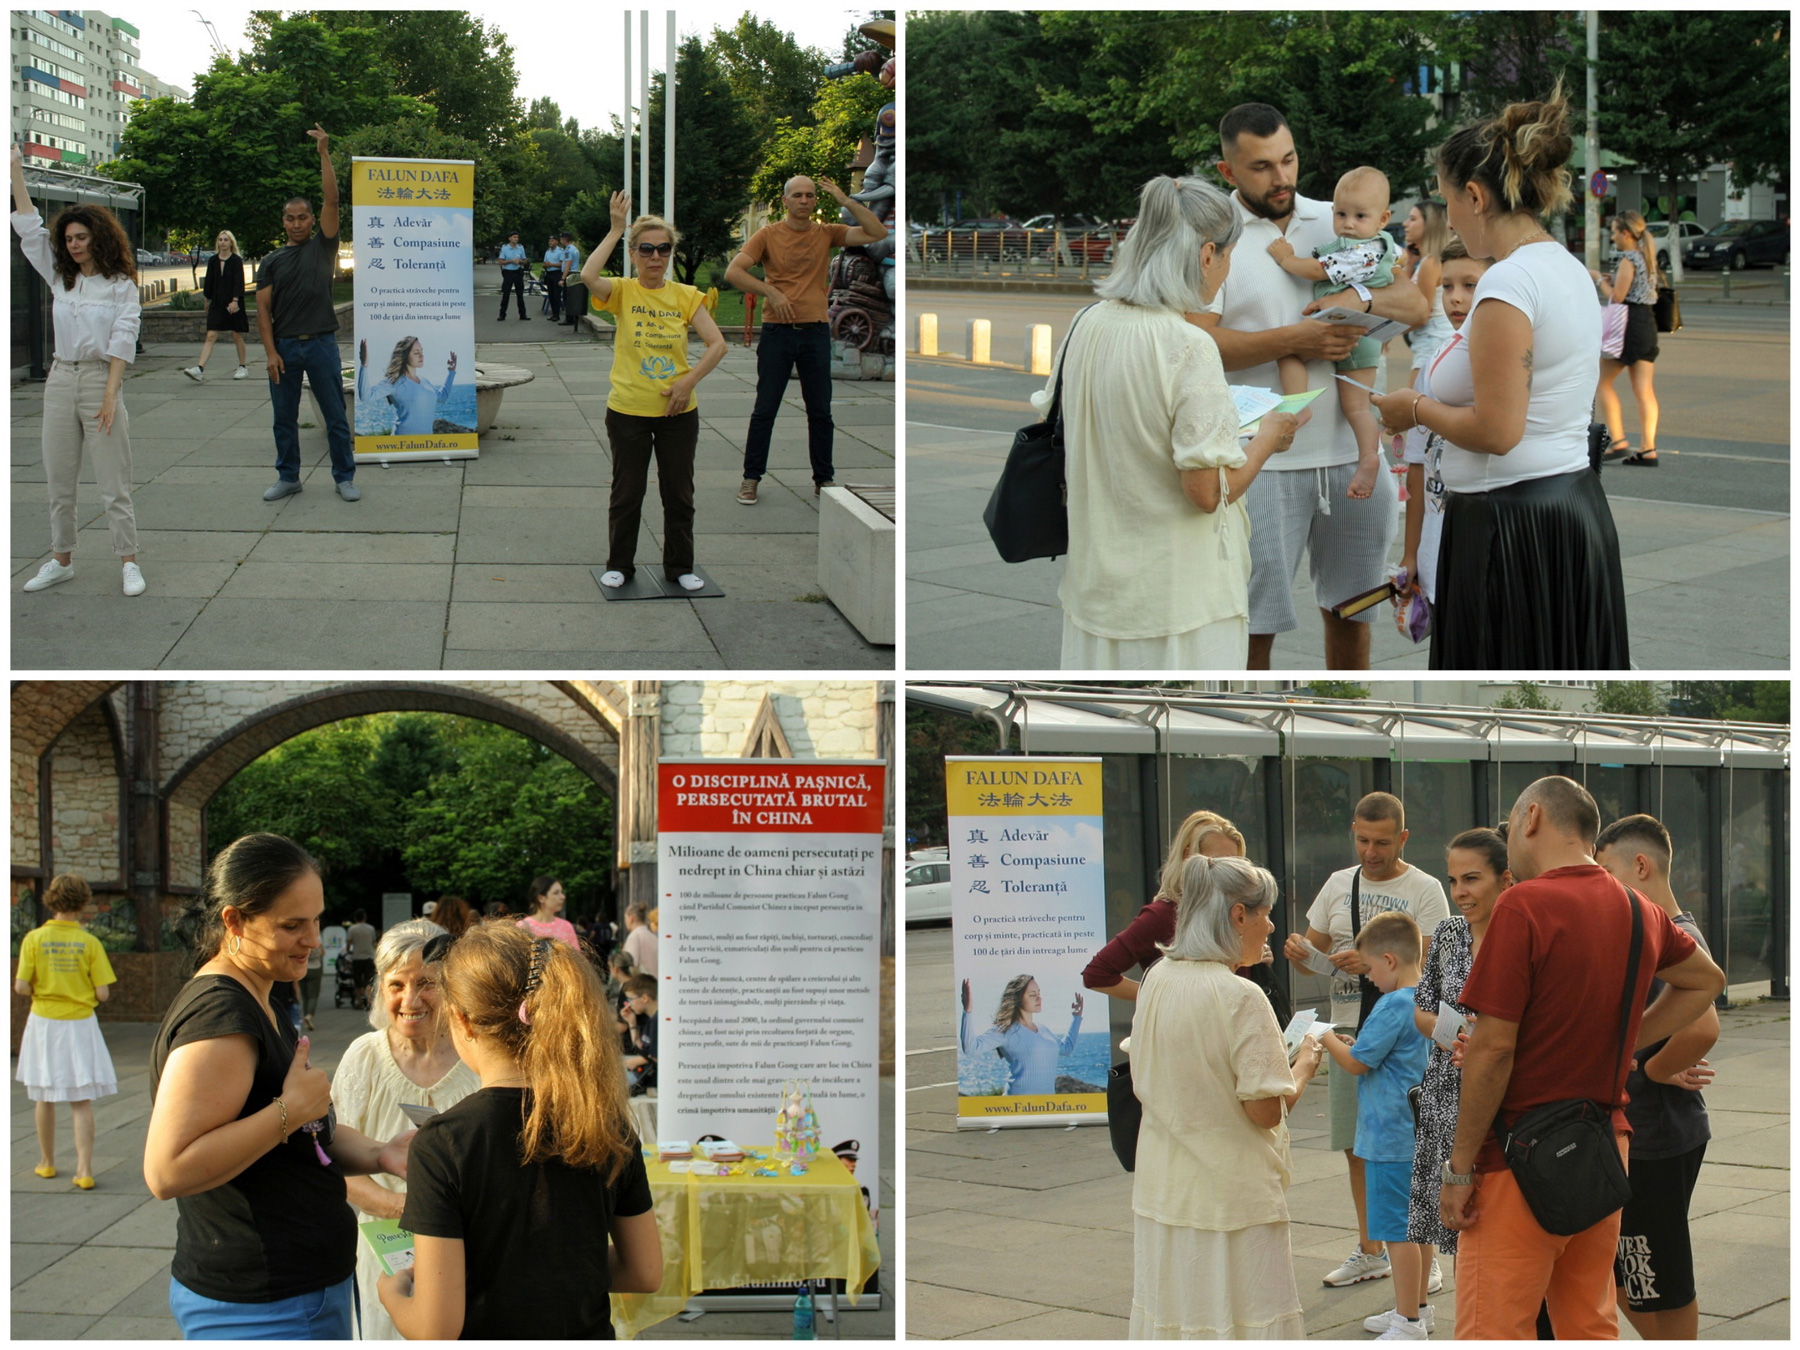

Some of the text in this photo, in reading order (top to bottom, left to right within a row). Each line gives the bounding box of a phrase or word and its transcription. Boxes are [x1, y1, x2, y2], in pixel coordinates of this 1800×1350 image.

[368, 169, 460, 183] FALUN DAFA
[377, 187, 451, 200] 法輪大法
[368, 216, 384, 228] 真
[394, 216, 432, 227] Adevăr
[367, 236, 385, 248] 善
[393, 236, 460, 251] Compasiune
[368, 258, 386, 270] 忍
[393, 258, 446, 272] Toleranță
[632, 306, 656, 318] FALN
[376, 440, 458, 450] www.FalunDafa.ro
[672, 774, 872, 792] O DISCIPLINĂ PAȘNICĂ,
[966, 771, 1083, 785] FALUN DAFA
[676, 792, 866, 806] PERSECUTATĂ BRUTAL
[978, 792, 1072, 807] 法輪大法
[732, 809, 813, 824] ÎN CHINA
[967, 829, 988, 844] 真
[1000, 828, 1048, 841] Adevăr
[668, 845, 874, 862] Milioane de oameni persecutați pe
[967, 853, 990, 868] 善
[1000, 853, 1086, 870] Compasiune
[679, 863, 726, 879] nedrept
[744, 864, 782, 876] China
[785, 864, 816, 876] chiar
[818, 865, 828, 879] și
[831, 865, 864, 876] astăzi
[968, 880, 991, 894] 忍
[1001, 880, 1068, 896] Toleranță
[1344, 893, 1409, 910] DWNTOWN
[985, 1102, 1086, 1112] www.FalunDafa.ro
